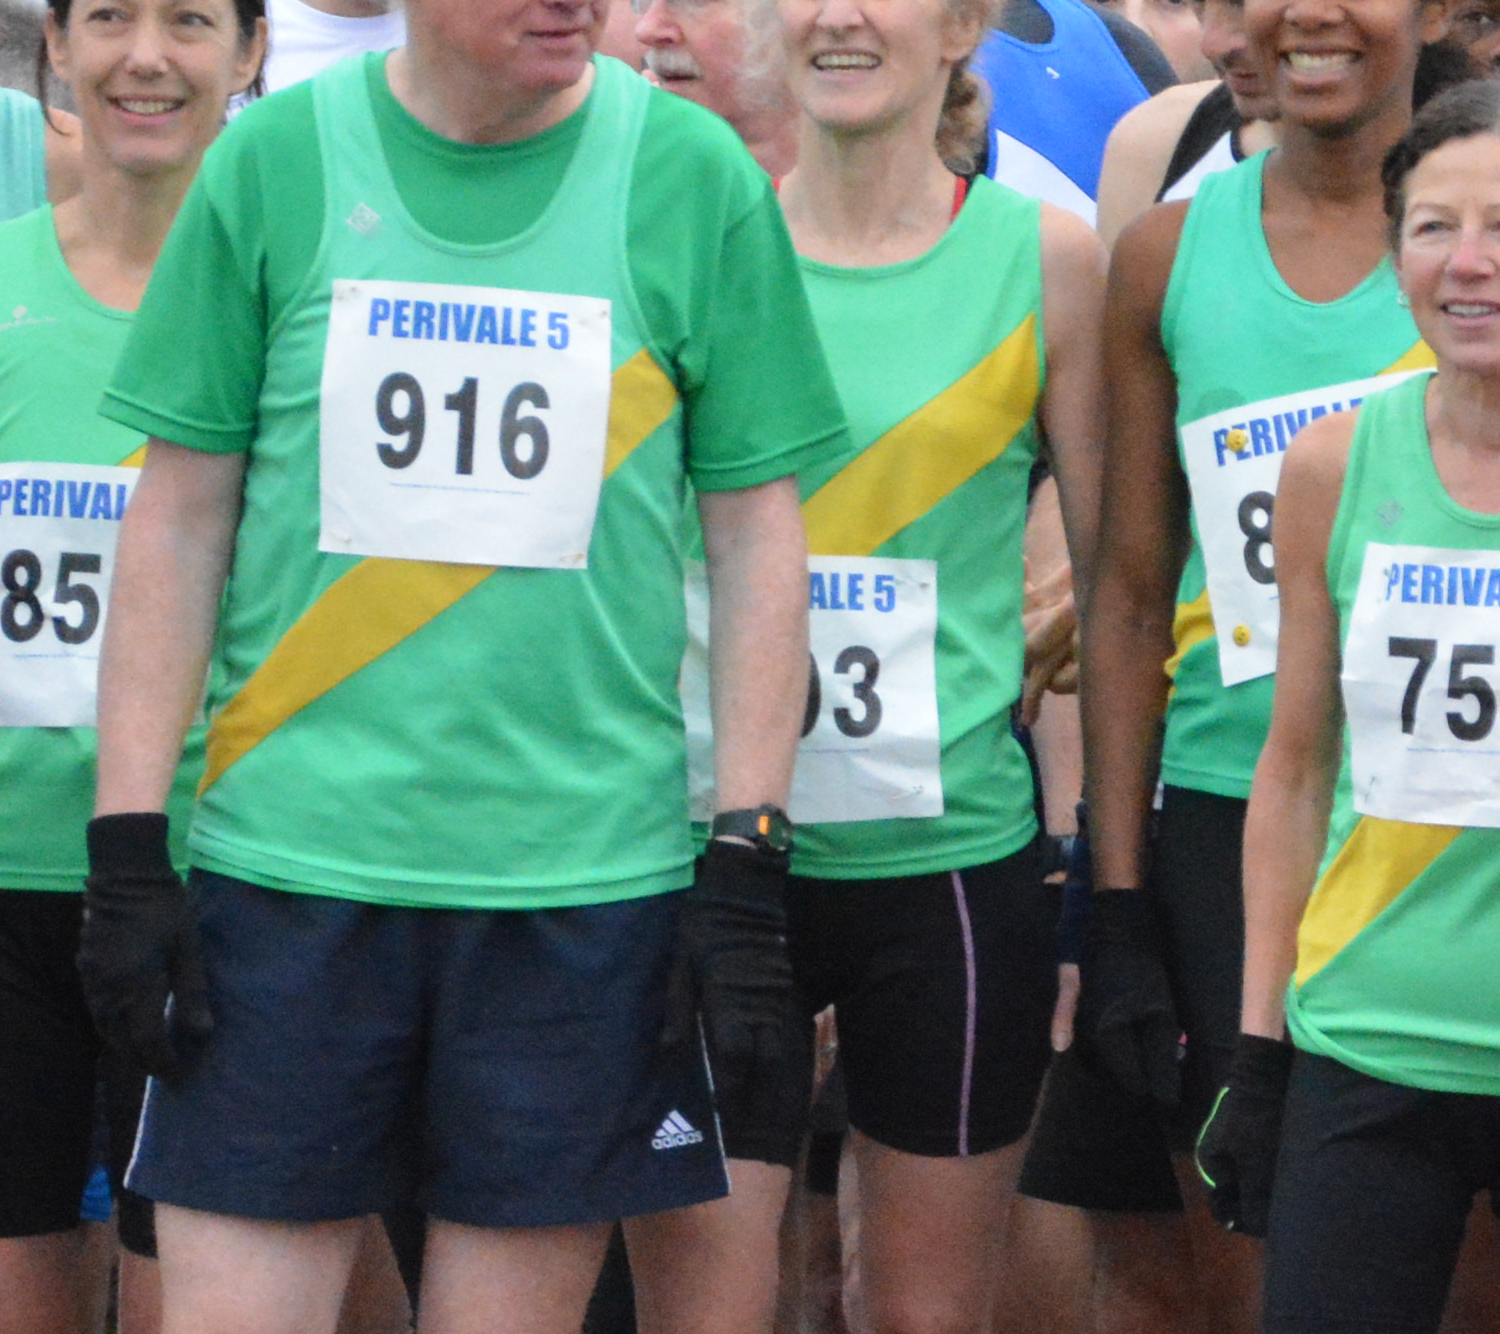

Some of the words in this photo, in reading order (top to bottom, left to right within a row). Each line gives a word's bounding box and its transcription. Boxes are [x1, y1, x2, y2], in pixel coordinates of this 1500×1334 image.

[368, 297, 536, 348] PERIVALE
[547, 311, 570, 351] 5
[375, 371, 550, 480] 916
[874, 574, 896, 613] 5
[651, 1130, 704, 1150] adidas
